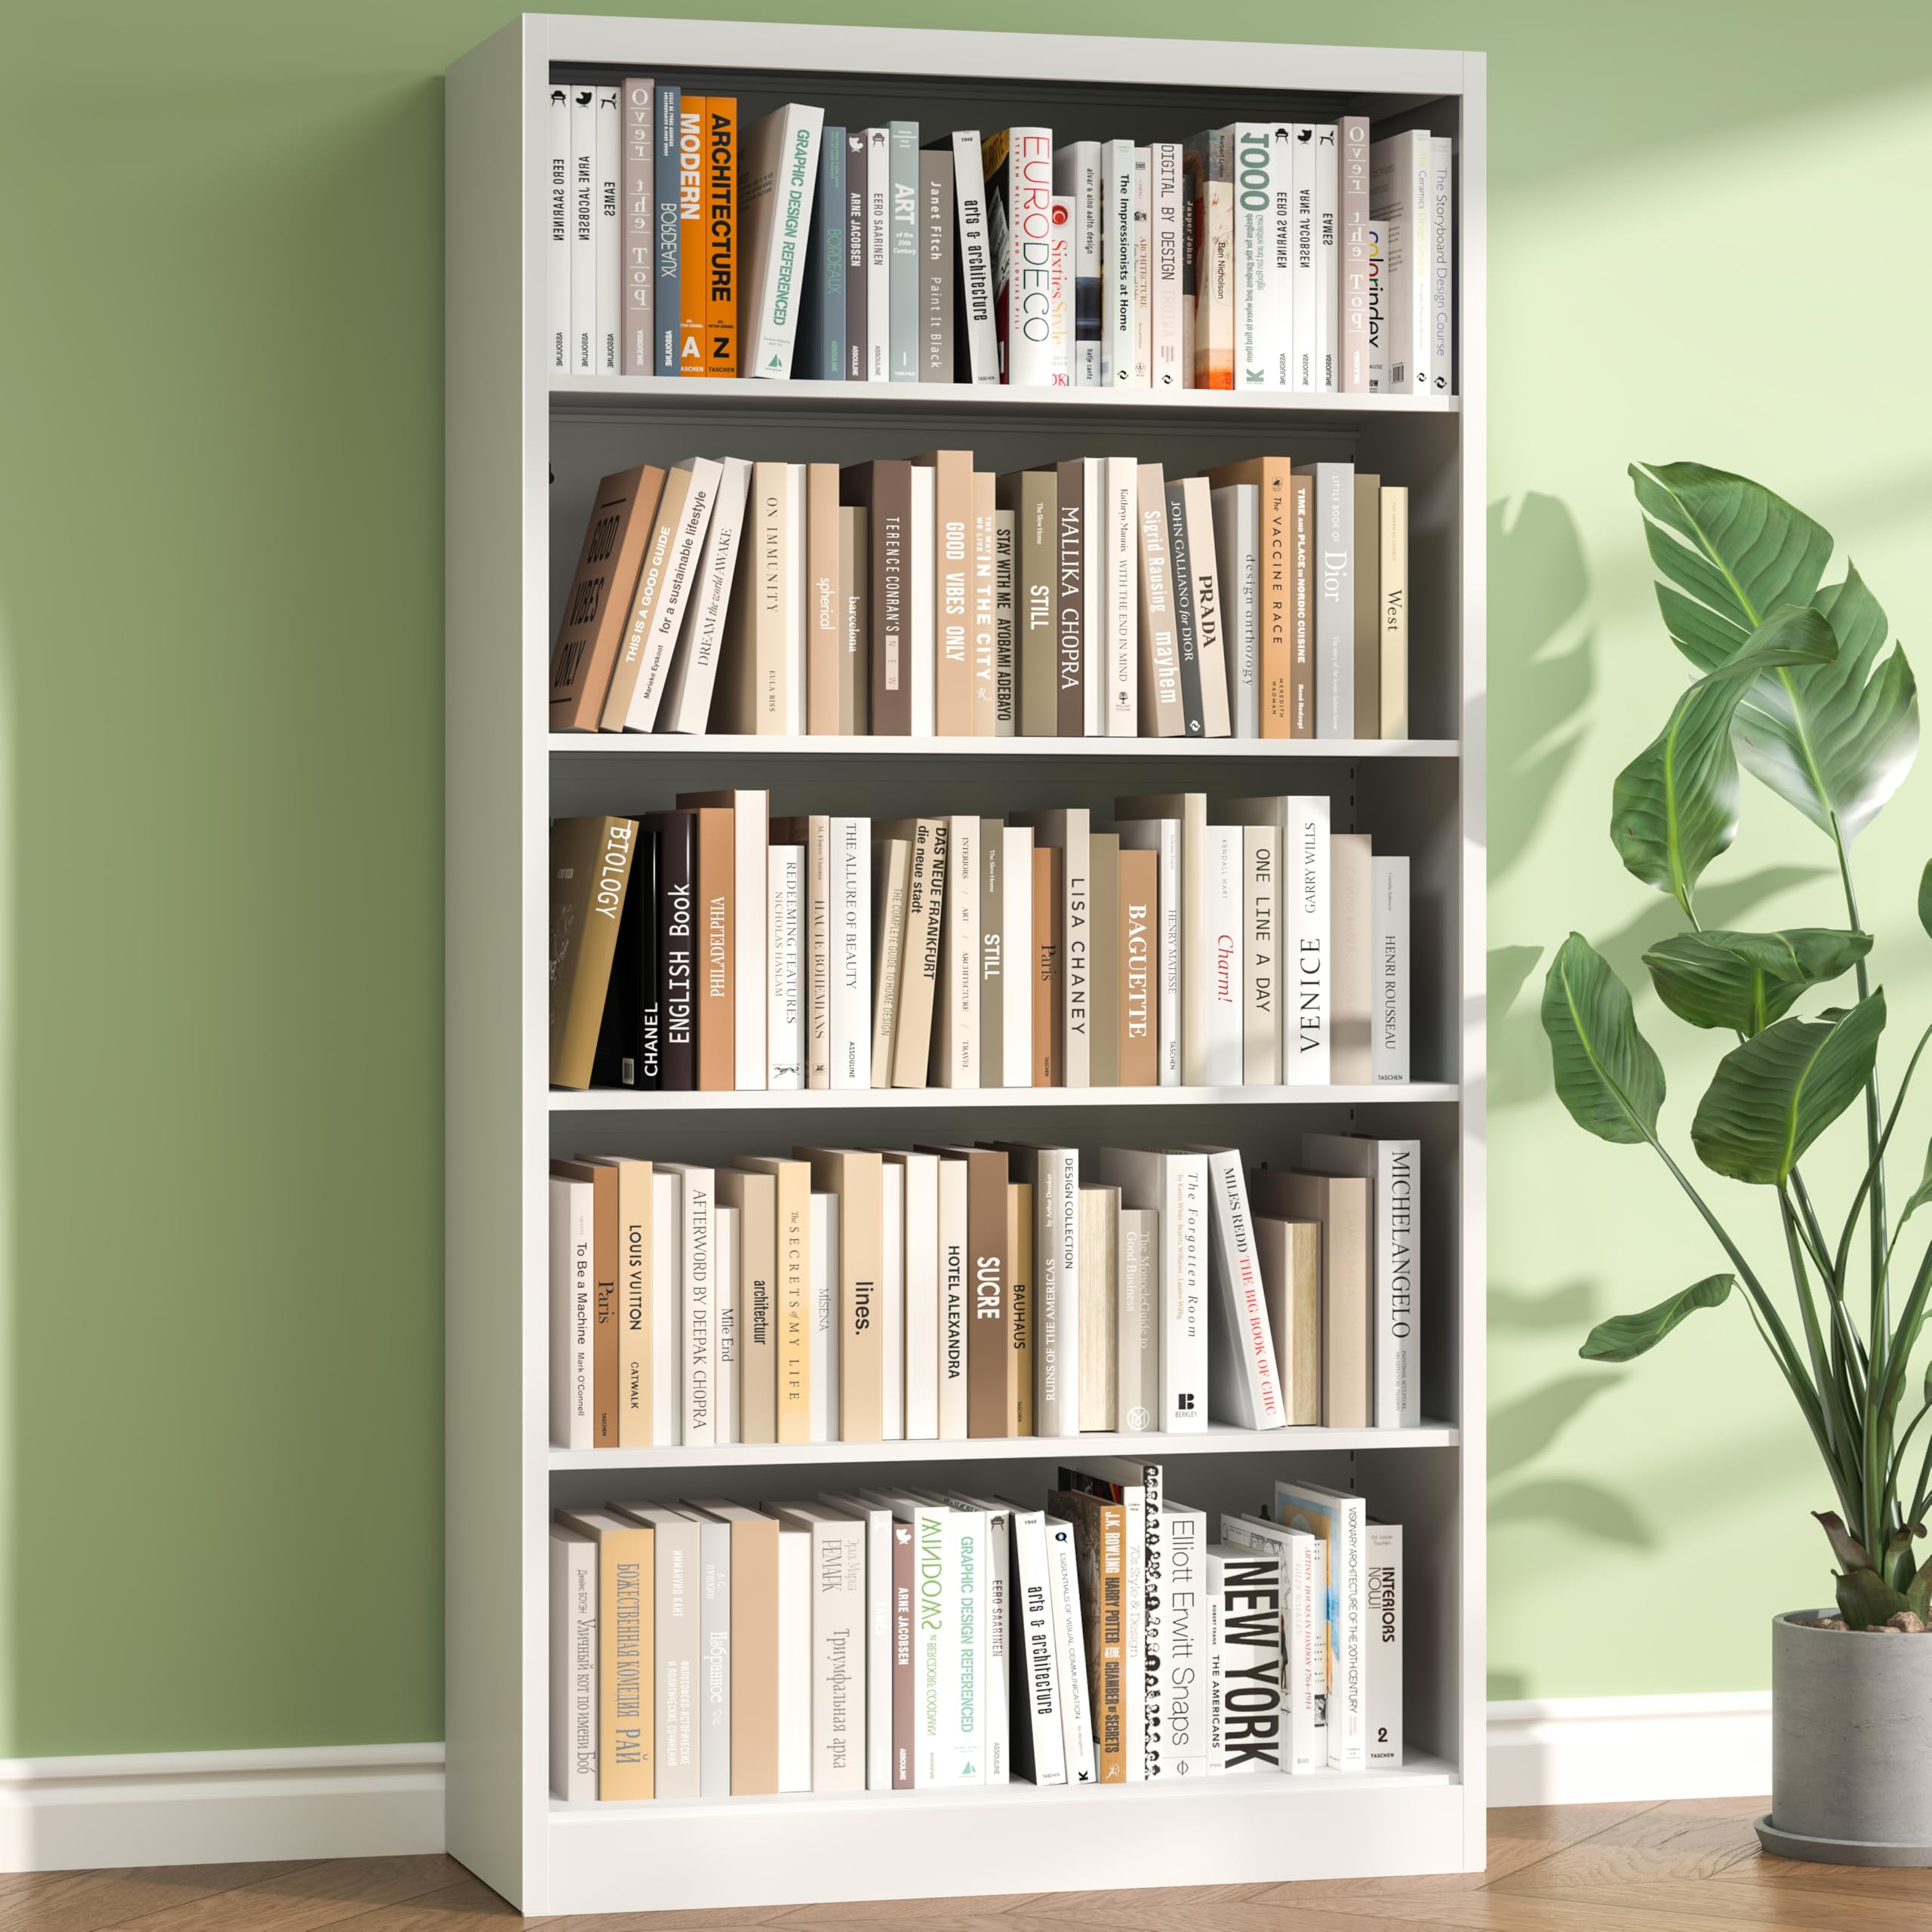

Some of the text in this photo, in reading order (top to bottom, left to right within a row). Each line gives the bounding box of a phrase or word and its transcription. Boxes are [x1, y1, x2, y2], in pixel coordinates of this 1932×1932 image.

[681, 113, 700, 220] MODERN
[790, 128, 810, 186] GRAPHIC
[894, 183, 915, 225] ART
[712, 113, 731, 301] ARCHITECTURE
[784, 190, 801, 238] DESIGN
[851, 192, 861, 266] ARNE JACOBSEN
[873, 193, 883, 266] EERO SAARINEN
[931, 181, 942, 260] Janet Fitch
[1118, 174, 1130, 331] The Impressionists at Home
[1161, 144, 1175, 280] DIGITAL BY DESIGN
[774, 241, 795, 326] REFERENCED
[1217, 242, 1226, 300] Ben Nicholson
[1433, 166, 1447, 356] The Storyboard Design Course
[930, 277, 942, 368] Paint It Black
[626, 526, 671, 663] THIS IS A GOOD GUIDE
[659, 491, 706, 634] for a sustainable lifestyle
[766, 497, 778, 612] ON IMMUNITY
[886, 517, 900, 632] TERENCE CONRAN'S
[946, 521, 964, 662] GOOD VIBES ONLY
[1062, 506, 1079, 690] MALLIKA CHOPRA
[1272, 497, 1282, 644] The VACCINE RACE
[1324, 550, 1348, 602] Dior
[815, 577, 835, 630] spherical
[848, 596, 860, 653] barcelona
[996, 529, 1011, 721] STAY WITH ME AYOBAMI ADEBAYO
[1030, 585, 1050, 630] STILL
[1198, 575, 1217, 648] PRADA
[1387, 589, 1402, 632] West
[595, 826, 632, 919] BIOLOGY
[845, 823, 857, 989] THE ALLURE OF BEAUTY
[923, 827, 947, 980] DAS NEUE FRANKFURT
[667, 884, 690, 1043] ENGLISH Book
[710, 896, 724, 997] PHILADELPHIA
[786, 862, 797, 1024] REDEEMING FEATURES
[1071, 878, 1085, 1035] LISA CHANEY
[1128, 903, 1147, 1038] BAGUETTE
[1217, 934, 1234, 1003] Charm!
[1256, 848, 1270, 1012] ONE LINE A DAY
[645, 1002, 658, 1077] CHANEL
[1300, 938, 1321, 1054] VENICE
[1385, 935, 1396, 1050] HENRI ROUSSEAU
[577, 1242, 587, 1257] To
[1065, 1158, 1074, 1269] DESIGN COLLECTION
[1392, 1151, 1411, 1339] MICHELANGELO
[577, 1261, 587, 1278] Be
[629, 1225, 641, 1331] LOUIS VUITTON
[693, 1189, 706, 1429] AFTERWORD BY DEEPAK CHOPRA
[753, 1280, 770, 1346] architectuur
[855, 1281, 874, 1335] lines.
[948, 1245, 960, 1380] HOTEL ALEXANDRA
[977, 1256, 1001, 1319] SUCRE
[1014, 1284, 1025, 1349] BAUHAUS
[577, 1293, 587, 1345] Machine
[721, 1308, 734, 1362] Mile End
[1045, 1259, 1056, 1401] RUINS OF THE AMERICAS
[630, 1361, 639, 1409] CATWALK
[961, 1536, 974, 1594] GRAPHIC
[1367, 1566, 1382, 1610] NOW!
[1382, 1567, 1395, 1643] INTERIORS
[612, 1563, 649, 1764] БОЖЕСТВЕННАЯ КОМЕДИЯ РАЙ
[898, 1587, 909, 1666] ARNE JACOBSEN
[961, 1597, 974, 1644] DESIGN
[1060, 1552, 1082, 1719] ESSENTIALS OF VISUAL COMMUNICATION
[1167, 1520, 1195, 1746] Elliott Erwitt Snaps
[1224, 1560, 1281, 1769] NEW YORK
[826, 1628, 852, 1769] Триумфальная арка
[961, 1648, 974, 1733] REFERENCED
[1212, 1655, 1220, 1749] THE AMERICANS
[1377, 1727, 1388, 1743] 2
